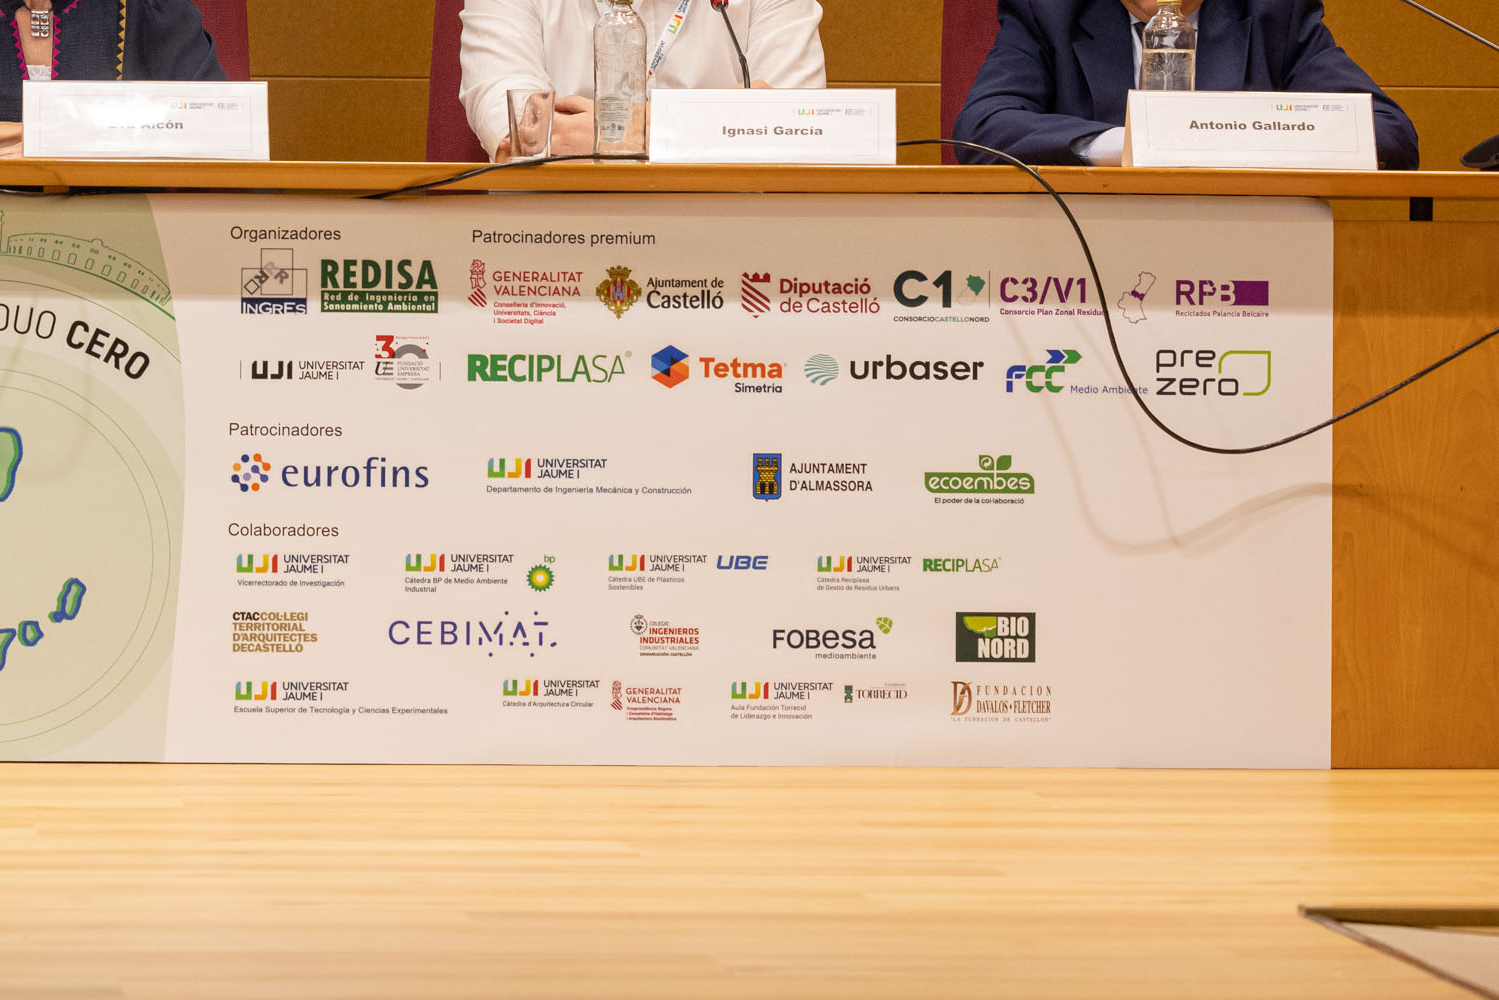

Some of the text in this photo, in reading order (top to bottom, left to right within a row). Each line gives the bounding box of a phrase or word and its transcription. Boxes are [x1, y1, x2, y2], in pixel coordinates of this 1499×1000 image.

[722, 125, 823, 137] Ignasi García
[1189, 120, 1315, 131] Antonio Gallardo
[230, 226, 341, 242] Organizadores
[472, 230, 656, 247] Patrocinadores premium
[320, 259, 438, 289] REDISA
[492, 270, 583, 282] GENERALITAT
[493, 285, 581, 297] VALENCIANA
[647, 278, 724, 290] Ajuntament de
[780, 278, 870, 297] Diputació
[893, 270, 952, 308] C1
[1000, 277, 1087, 304] C3/V1
[324, 292, 341, 301] Red
[348, 292, 360, 301] de
[365, 292, 418, 303] Ingeniería
[647, 290, 724, 309] Castelló
[324, 302, 435, 311] Saneamiento Ambiental
[780, 297, 880, 314] de Castelló
[65, 319, 151, 380] CERO
[298, 361, 365, 370] UNIVERSITAT
[467, 353, 626, 383] RECIPLASA
[699, 358, 783, 379] Tetma
[850, 355, 984, 381] urbaser
[1156, 349, 1216, 373] pre
[251, 360, 293, 379] UJI
[298, 370, 334, 380] JAUME
[1070, 385, 1099, 394] Medio
[1156, 377, 1238, 396] zero
[229, 422, 342, 437] Patrocinadores
[487, 458, 531, 478] UJI
[537, 458, 607, 468] UNIVERSITAT
[790, 463, 867, 474] AJUNTAMENT
[282, 457, 429, 488] eurofins
[537, 469, 574, 478] JAUME
[790, 480, 873, 492] D'ALMASSORA
[929, 474, 1030, 491] ecoembes
[228, 523, 339, 536] Colaboradores
[544, 555, 555, 563] bp
[717, 555, 768, 570] UBE
[923, 558, 999, 572] RECIPLASA
[233, 623, 305, 631] TERRITORIAL
[389, 616, 557, 651] CEBIMAT
[997, 617, 1029, 636] BIO
[978, 638, 1029, 658] NORD
[856, 689, 907, 699] TORRECID
